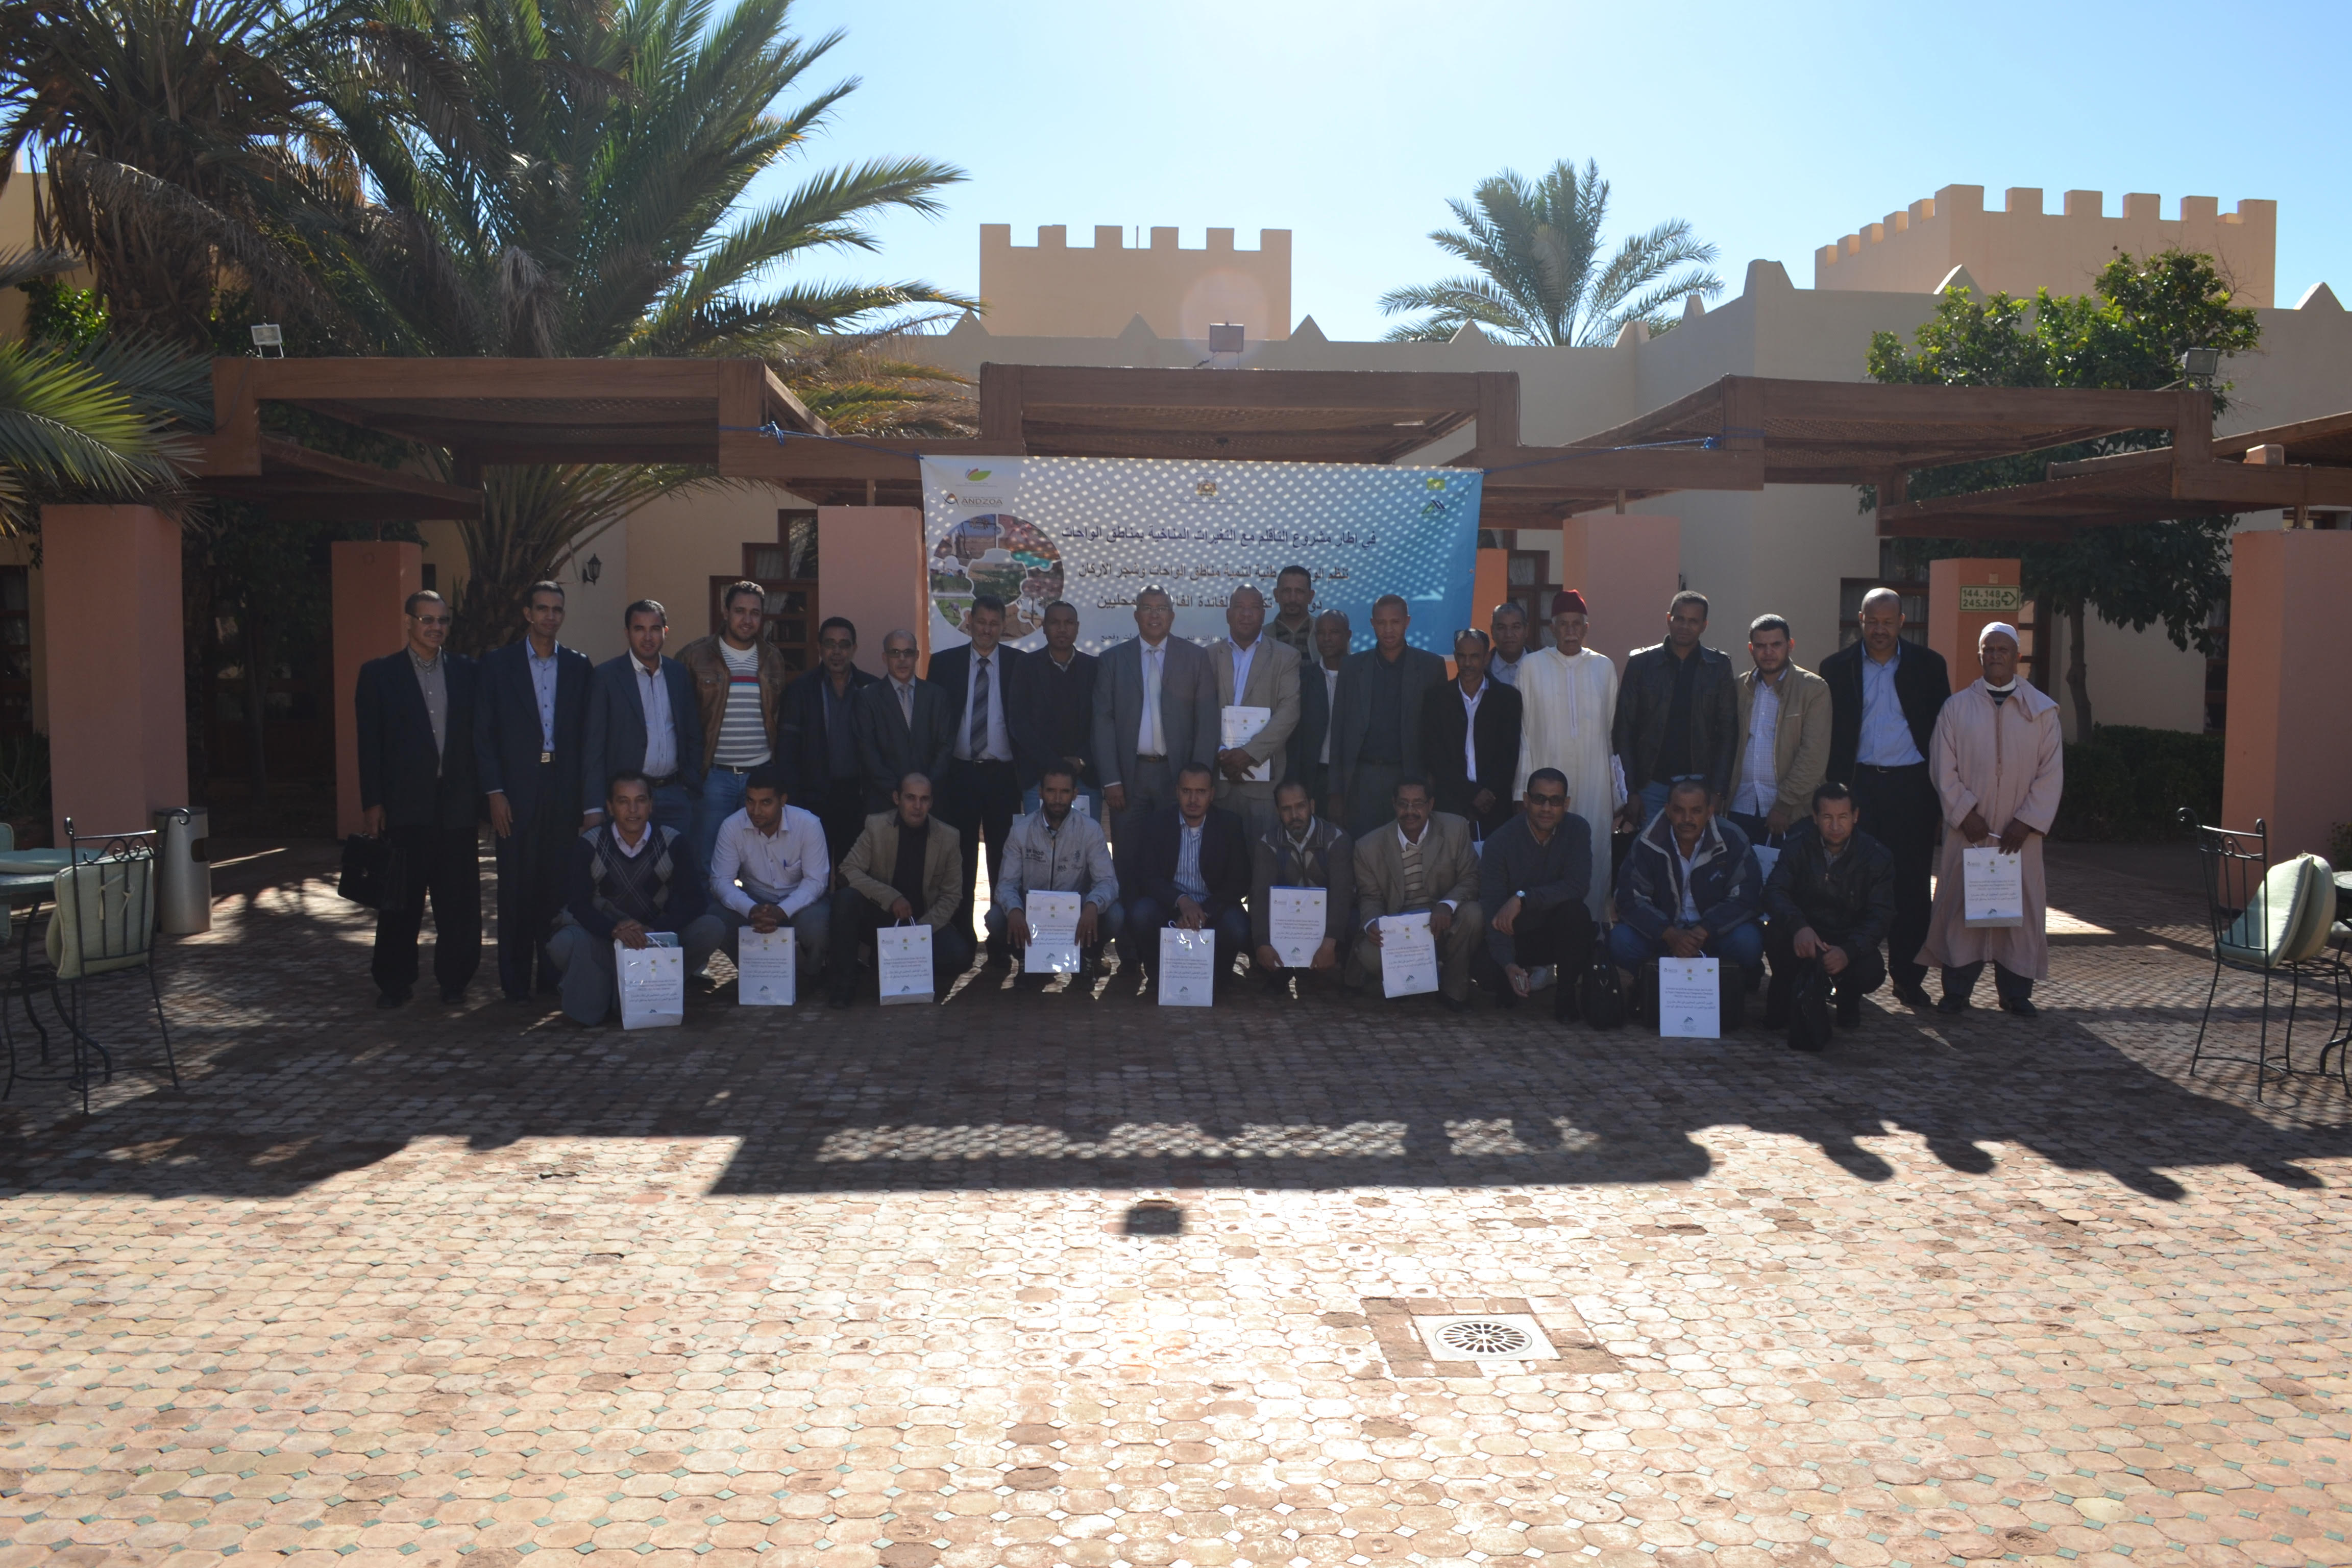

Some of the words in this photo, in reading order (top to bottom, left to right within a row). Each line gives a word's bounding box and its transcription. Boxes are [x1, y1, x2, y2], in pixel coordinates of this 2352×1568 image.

[1062, 526, 1102, 541] الواحات
[1107, 526, 1144, 543] بمناطق
[1148, 525, 1189, 543] المناخية
[1194, 528, 1236, 544] التغيرات
[1240, 532, 1254, 547] مع
[1259, 527, 1288, 547] التأقلم
[1292, 531, 1331, 548] مشروع
[1335, 530, 1357, 548] إطار
[1361, 530, 1376, 550] في
[1079, 560, 1112, 577] الأركان
[1116, 562, 1145, 578] وشجر
[1149, 564, 1186, 579] الواحات
[1190, 564, 1220, 581] مناطق
[1224, 563, 1251, 581] لتنمية
[1328, 567, 1349, 584] تنظم
[1198, 595, 1229, 607] لفائدة
[1963, 599, 2001, 607] 245.249
